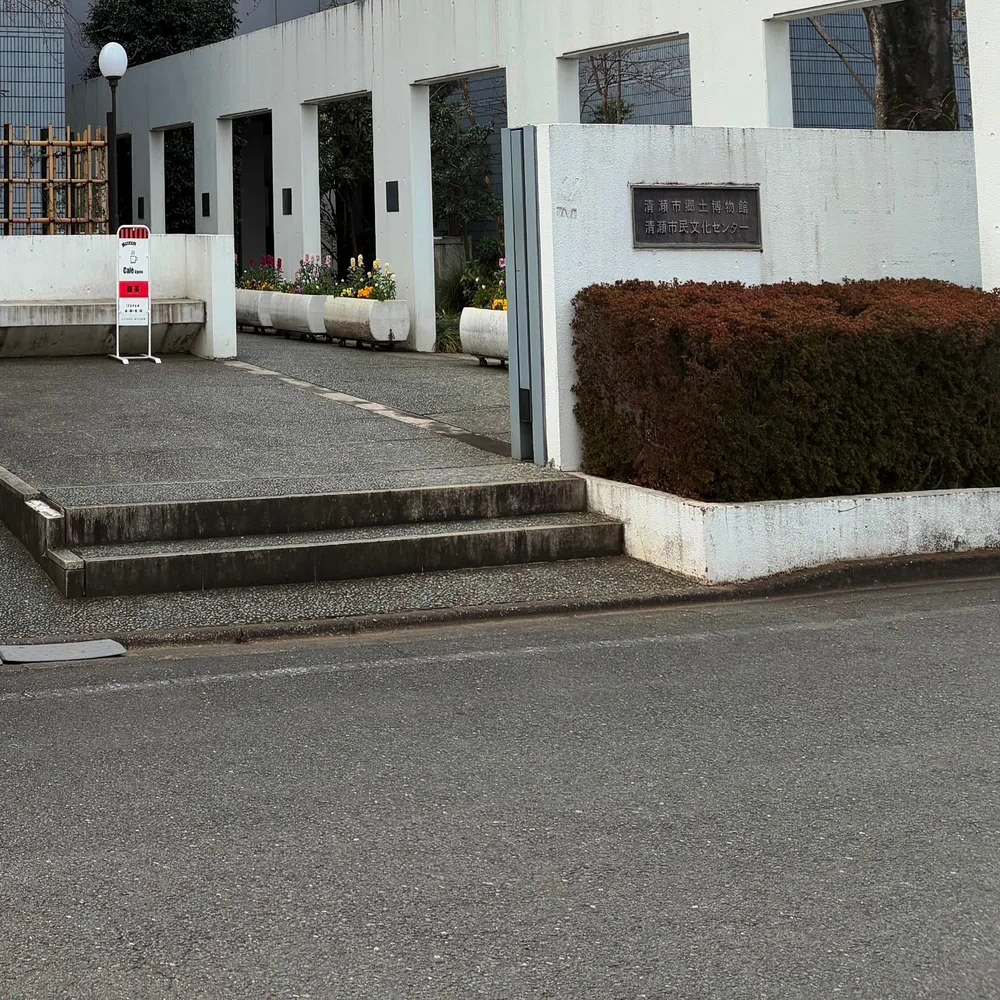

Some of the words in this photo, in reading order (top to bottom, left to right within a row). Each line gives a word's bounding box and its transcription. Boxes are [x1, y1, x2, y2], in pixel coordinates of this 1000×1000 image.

[643, 199, 748, 214] 清瀬市郷土博物館
[644, 220, 749, 235] 清瀬市民文化センター
